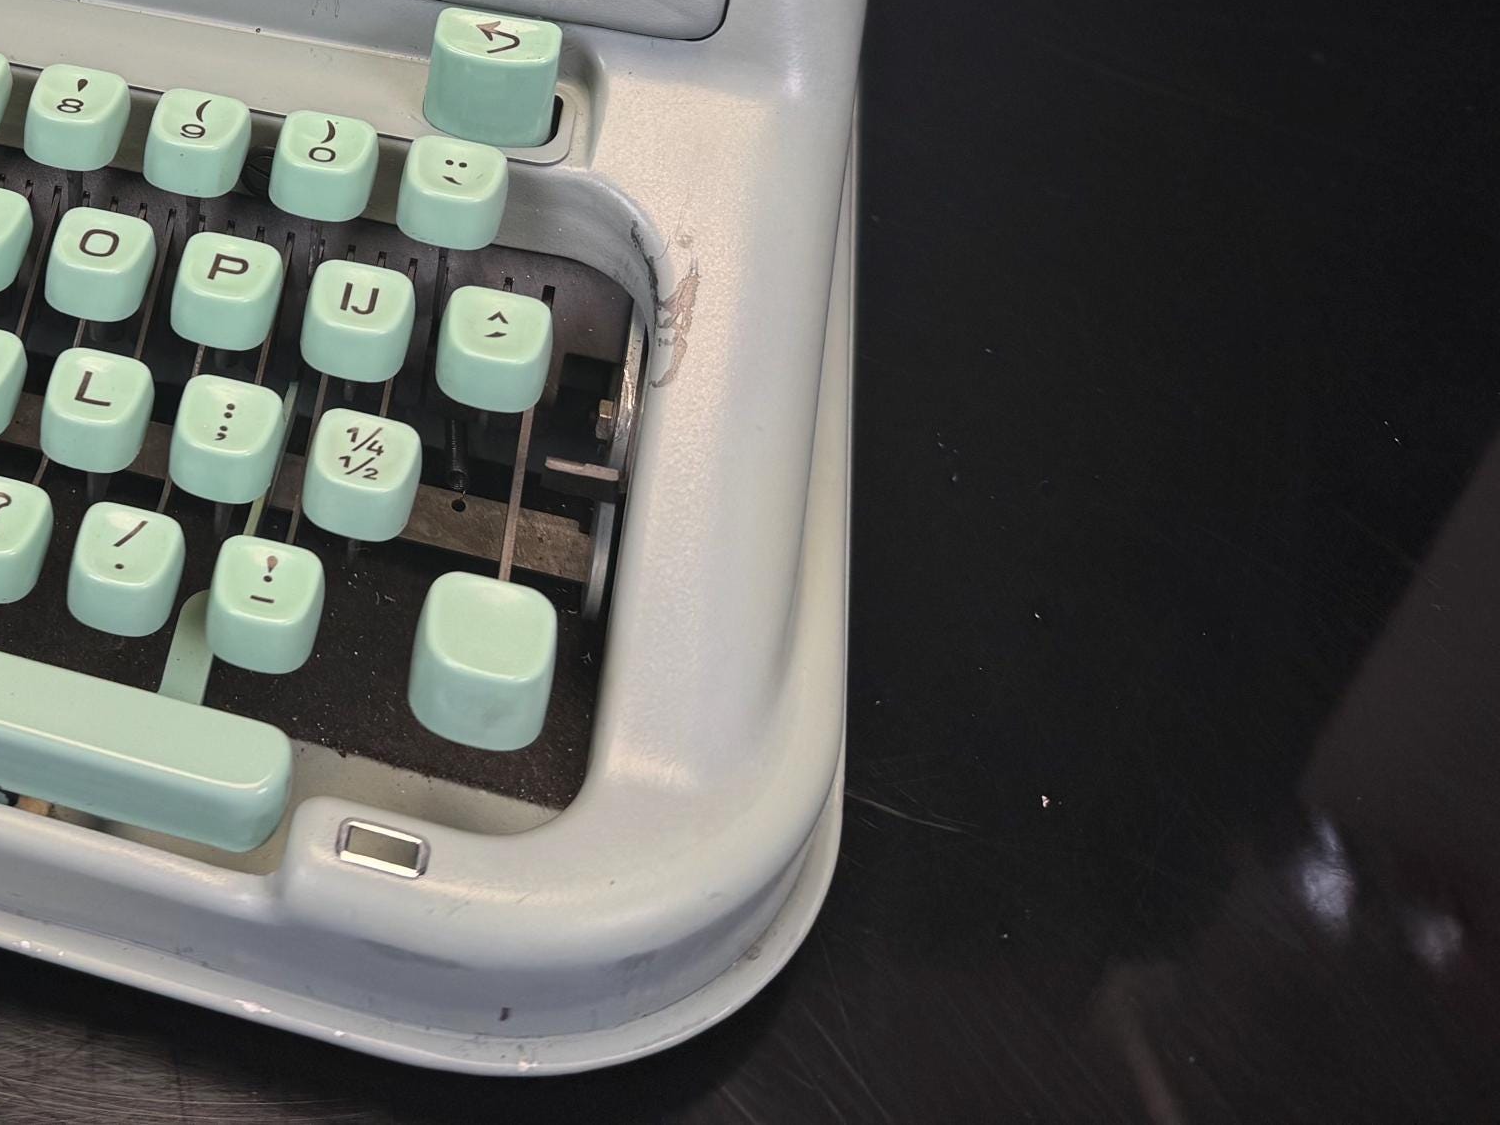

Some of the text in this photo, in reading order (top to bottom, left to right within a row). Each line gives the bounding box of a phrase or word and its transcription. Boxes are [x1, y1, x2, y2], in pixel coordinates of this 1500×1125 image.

[57, 99, 84, 113] 8
[196, 100, 211, 122] (
[180, 124, 205, 139] 9
[321, 120, 335, 143] )
[79, 229, 119, 257] O
[207, 253, 249, 280] P
[340, 282, 379, 315] IJ
[74, 371, 111, 406] L
[224, 404, 235, 419] :
[113, 521, 148, 547] /
[263, 556, 277, 582] !
